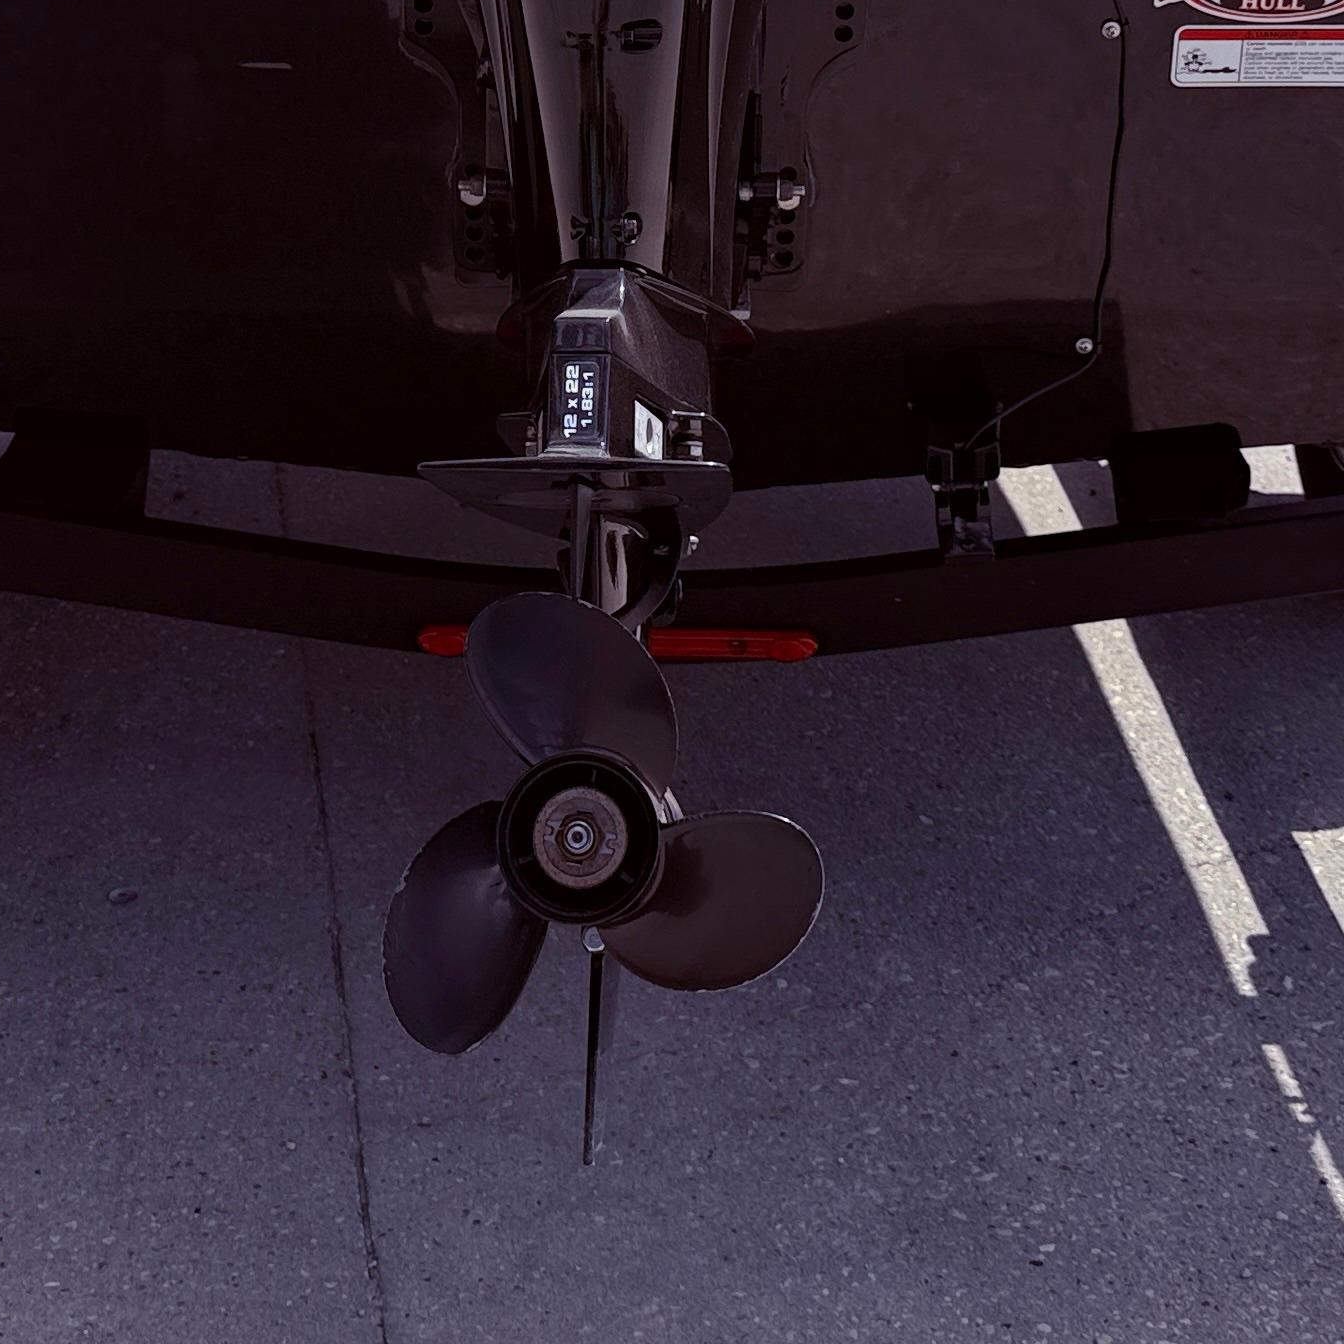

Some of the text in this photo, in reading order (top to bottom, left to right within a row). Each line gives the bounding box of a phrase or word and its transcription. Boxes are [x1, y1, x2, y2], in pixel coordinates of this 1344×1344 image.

[565, 364, 580, 394] 22
[580, 371, 595, 428] 1.83:1
[563, 413, 578, 439] 12
